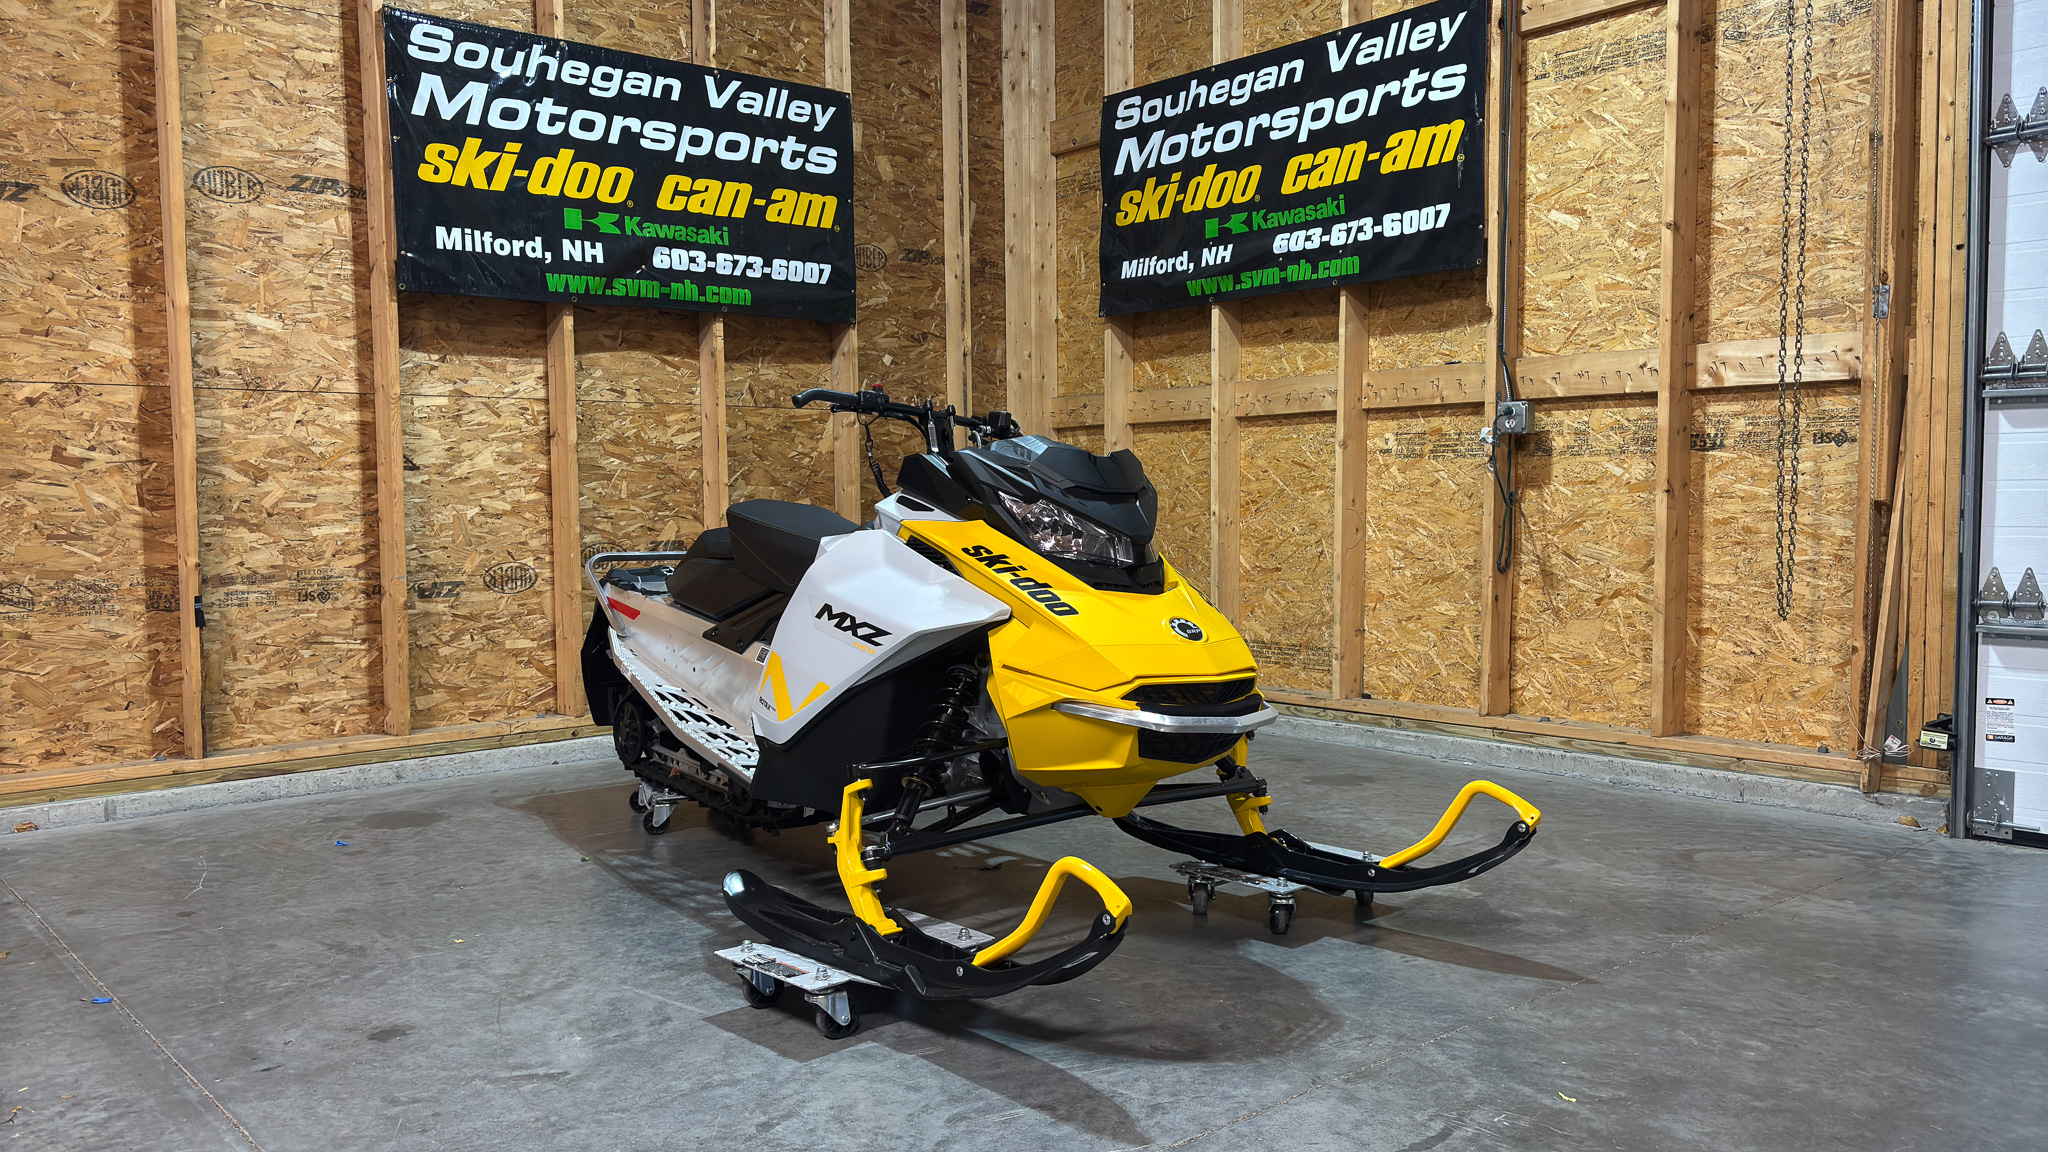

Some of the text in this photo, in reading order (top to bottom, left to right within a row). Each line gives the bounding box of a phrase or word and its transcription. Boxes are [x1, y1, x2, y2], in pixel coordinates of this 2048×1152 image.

[407, 22, 837, 132] Souhegan Valley
[1113, 11, 1468, 130] Souhegan Valley
[410, 71, 838, 175] Motorsports
[1113, 63, 1468, 176] Motorsports
[417, 136, 838, 229] ski-doo can-am
[1115, 164, 1262, 227] ski-doo
[1280, 118, 1466, 196] can-am
[625, 216, 729, 246] Kawasaki
[1252, 195, 1345, 231] Kawasaki
[1272, 203, 1451, 254] 603-673-6007
[435, 225, 605, 265] Milford, NH
[652, 246, 832, 285] 603-673-6007
[1121, 243, 1234, 280] Milford, NH
[546, 272, 752, 306] www.svm-nh.com
[1187, 255, 1360, 297] www.svm-nh.com
[298, 591, 316, 602] SFI
[960, 544, 1080, 617] ski-doo
[814, 603, 893, 647] MXZ
[853, 641, 875, 655] NEO
[758, 696, 772, 712] ROTAX
